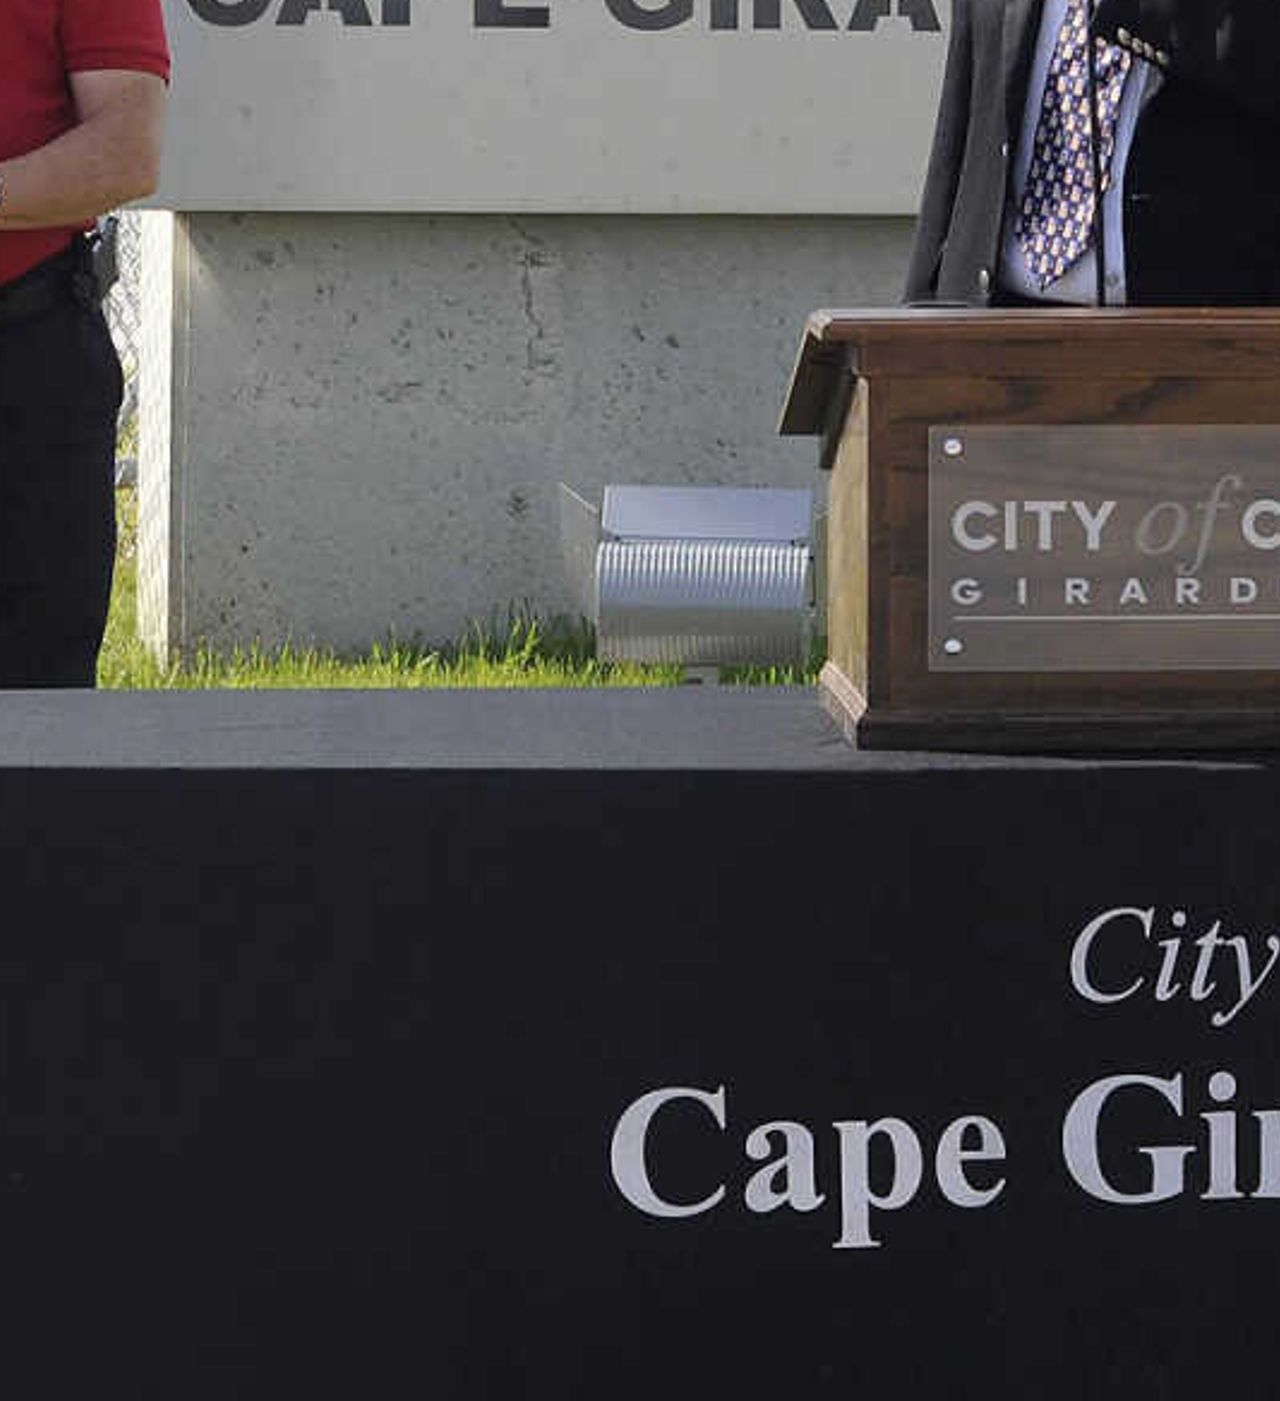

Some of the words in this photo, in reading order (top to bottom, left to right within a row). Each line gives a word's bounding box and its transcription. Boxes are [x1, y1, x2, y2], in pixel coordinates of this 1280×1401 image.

[951, 500, 1117, 551] CITY
[1135, 473, 1243, 576] of
[1070, 906, 1280, 1027] City
[610, 1085, 1007, 1249] Cape
